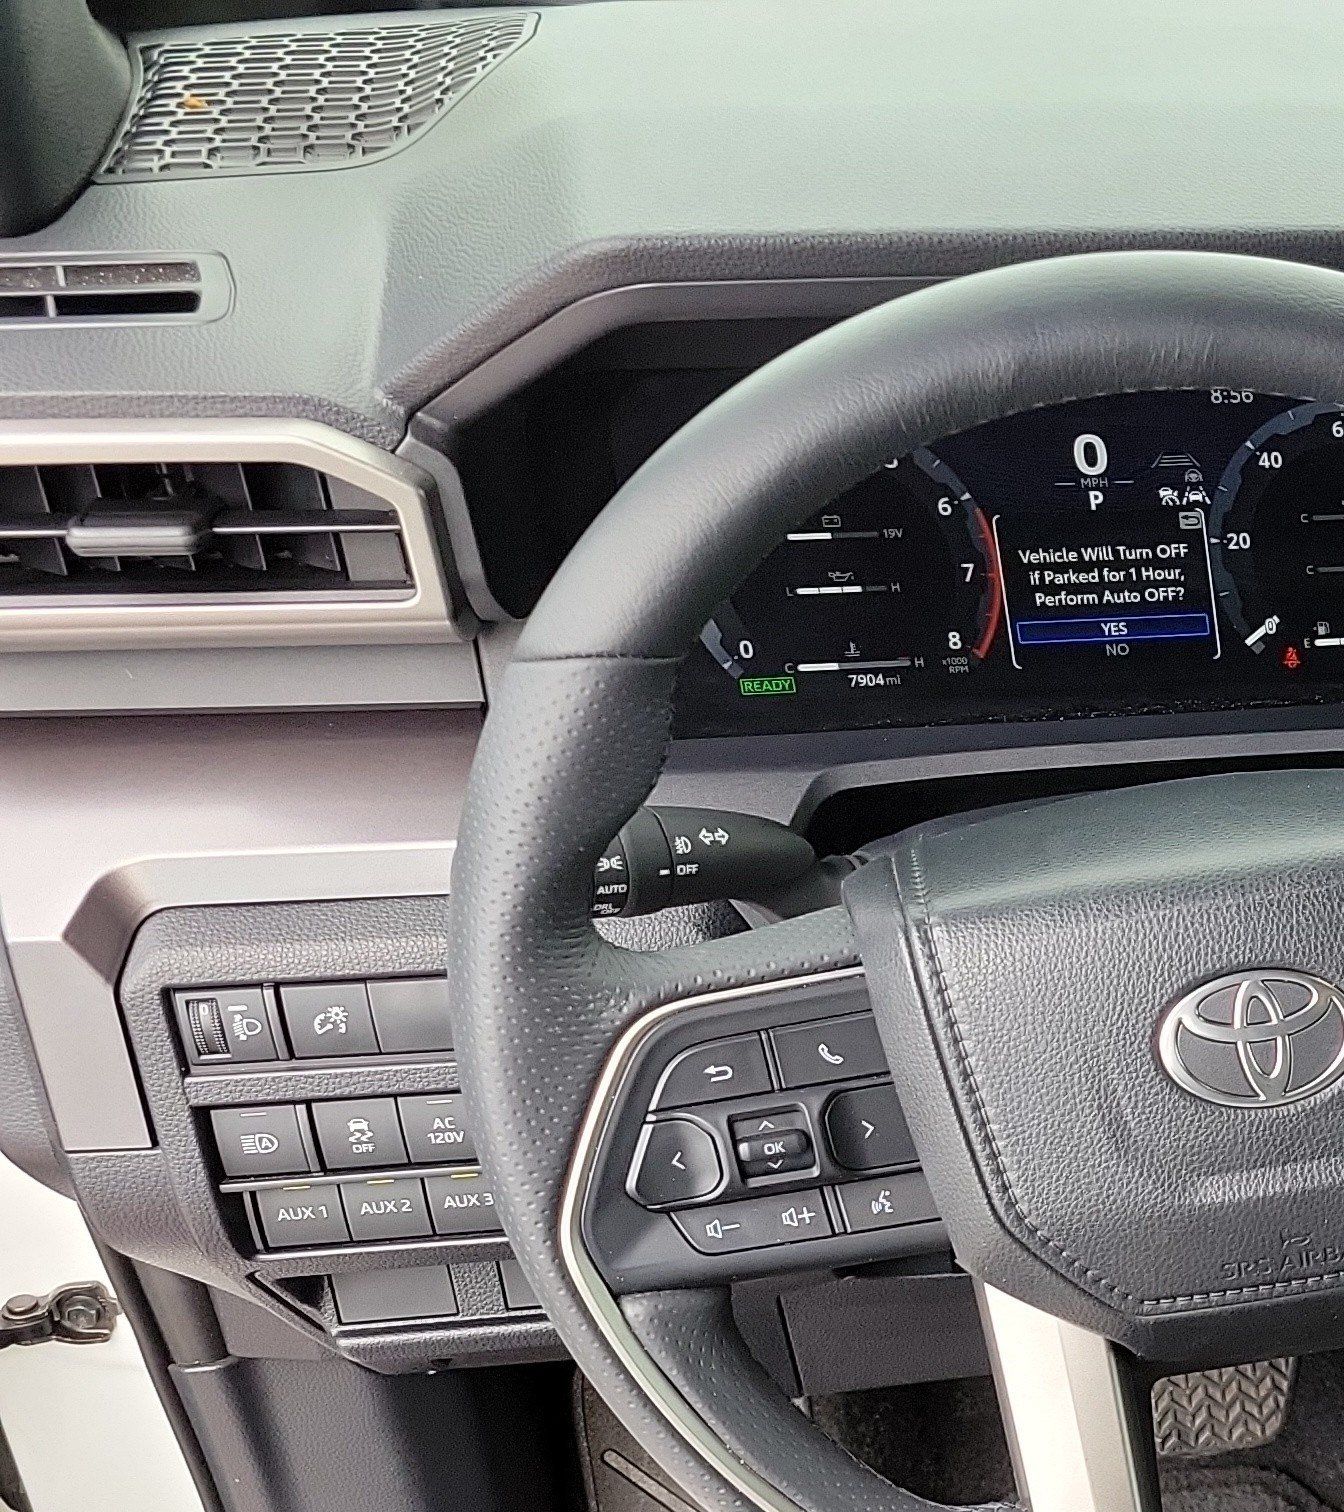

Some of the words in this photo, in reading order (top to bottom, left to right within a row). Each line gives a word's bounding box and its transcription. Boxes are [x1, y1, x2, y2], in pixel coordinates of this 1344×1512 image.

[1072, 433, 1109, 477] 0
[1257, 451, 1283, 469] 40
[1080, 476, 1109, 489] MPH
[937, 496, 953, 516] 6
[1088, 491, 1105, 511] P
[1300, 513, 1309, 523] C
[882, 527, 903, 538] 19V
[1226, 533, 1252, 551] 20
[1018, 547, 1079, 564] Vehicle
[1081, 545, 1114, 562] Will
[1116, 546, 1153, 561] Turn
[1156, 543, 1189, 559] OFF
[960, 563, 975, 583] 7
[1029, 570, 1041, 586] if
[1044, 568, 1100, 585] Parked
[1103, 567, 1126, 583] for
[1128, 567, 1137, 582] 1
[1141, 567, 1185, 582] Hour,
[1306, 565, 1314, 575] C
[786, 587, 795, 597] L
[891, 582, 901, 593] H
[1035, 591, 1099, 607] Perform
[1102, 589, 1141, 604] Auto
[1144, 587, 1185, 602] OFF?
[1100, 622, 1128, 636] YES
[1265, 617, 1277, 635] 0
[947, 631, 962, 650] 8
[1303, 637, 1311, 649] E
[739, 640, 754, 659] 0
[1105, 643, 1130, 657] NO
[785, 663, 795, 674] C
[914, 657, 925, 668] H
[948, 665, 969, 674] RPM
[743, 679, 793, 693] READY
[847, 673, 885, 688] 7904
[885, 675, 902, 686] mi
[676, 864, 700, 876] OFF
[596, 883, 628, 895] AUTO
[432, 1117, 456, 1130] AC
[426, 1130, 465, 1146] 120V
[352, 1143, 376, 1154] OFF
[763, 1140, 786, 1155] OK
[360, 1201, 397, 1216] AUX
[400, 1199, 413, 1213] 2
[443, 1194, 480, 1210] AUX
[482, 1192, 495, 1207] 3
[277, 1207, 315, 1222] AUX
[318, 1205, 329, 1219] 1
